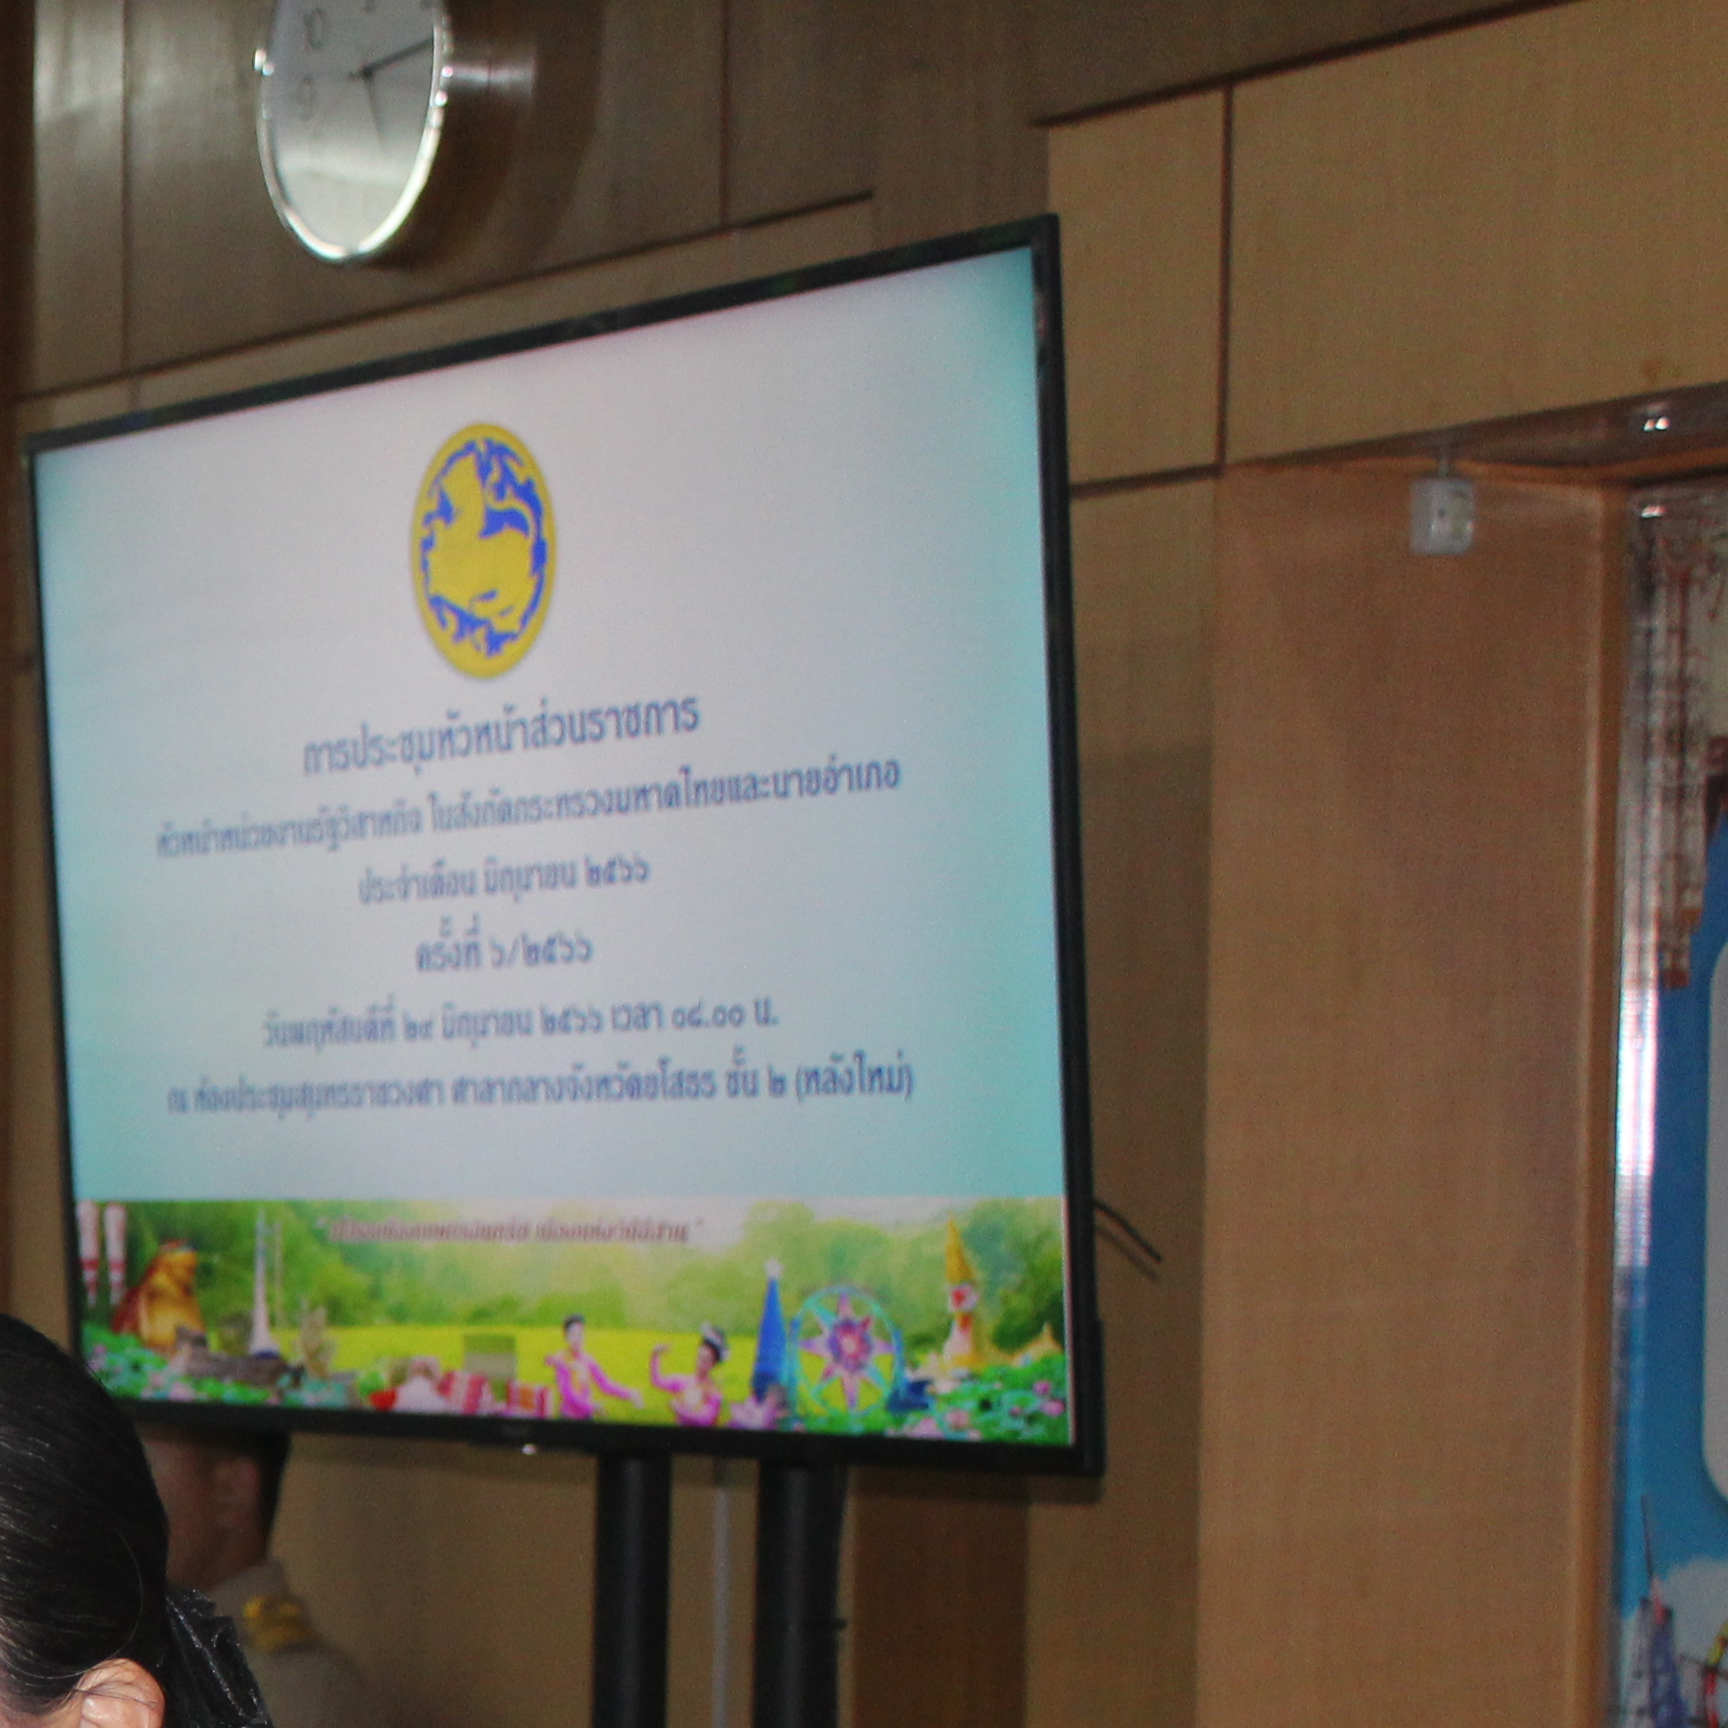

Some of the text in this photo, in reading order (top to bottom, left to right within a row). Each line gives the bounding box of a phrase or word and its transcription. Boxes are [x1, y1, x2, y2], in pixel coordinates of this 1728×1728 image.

[304, 696, 701, 776] การประชุมหัวหน้าส่วนราชการ
[156, 798, 423, 857] หัวหน้าหน่วยงานรัฐวิสาหกิจ
[359, 854, 651, 905] ประจำเดือน มิถุนายน ๒๕๖๖
[416, 912, 594, 971] ครั้งที่ ๖/๒๕๖๖
[264, 992, 395, 1053] วันพฤหัสบดีที่
[442, 1001, 534, 1049] มิถุนายน
[541, 1002, 604, 1035] ๒๕๖๖
[611, 1000, 664, 1032] เวลา
[754, 998, 780, 1026] น.
[451, 1055, 717, 1106] ศาลากลางจังหวัดยโสธร
[724, 1044, 759, 1098] ชั้น
[768, 1065, 788, 1096] ๒
[795, 1047, 915, 1103] (หลังใหม่)
